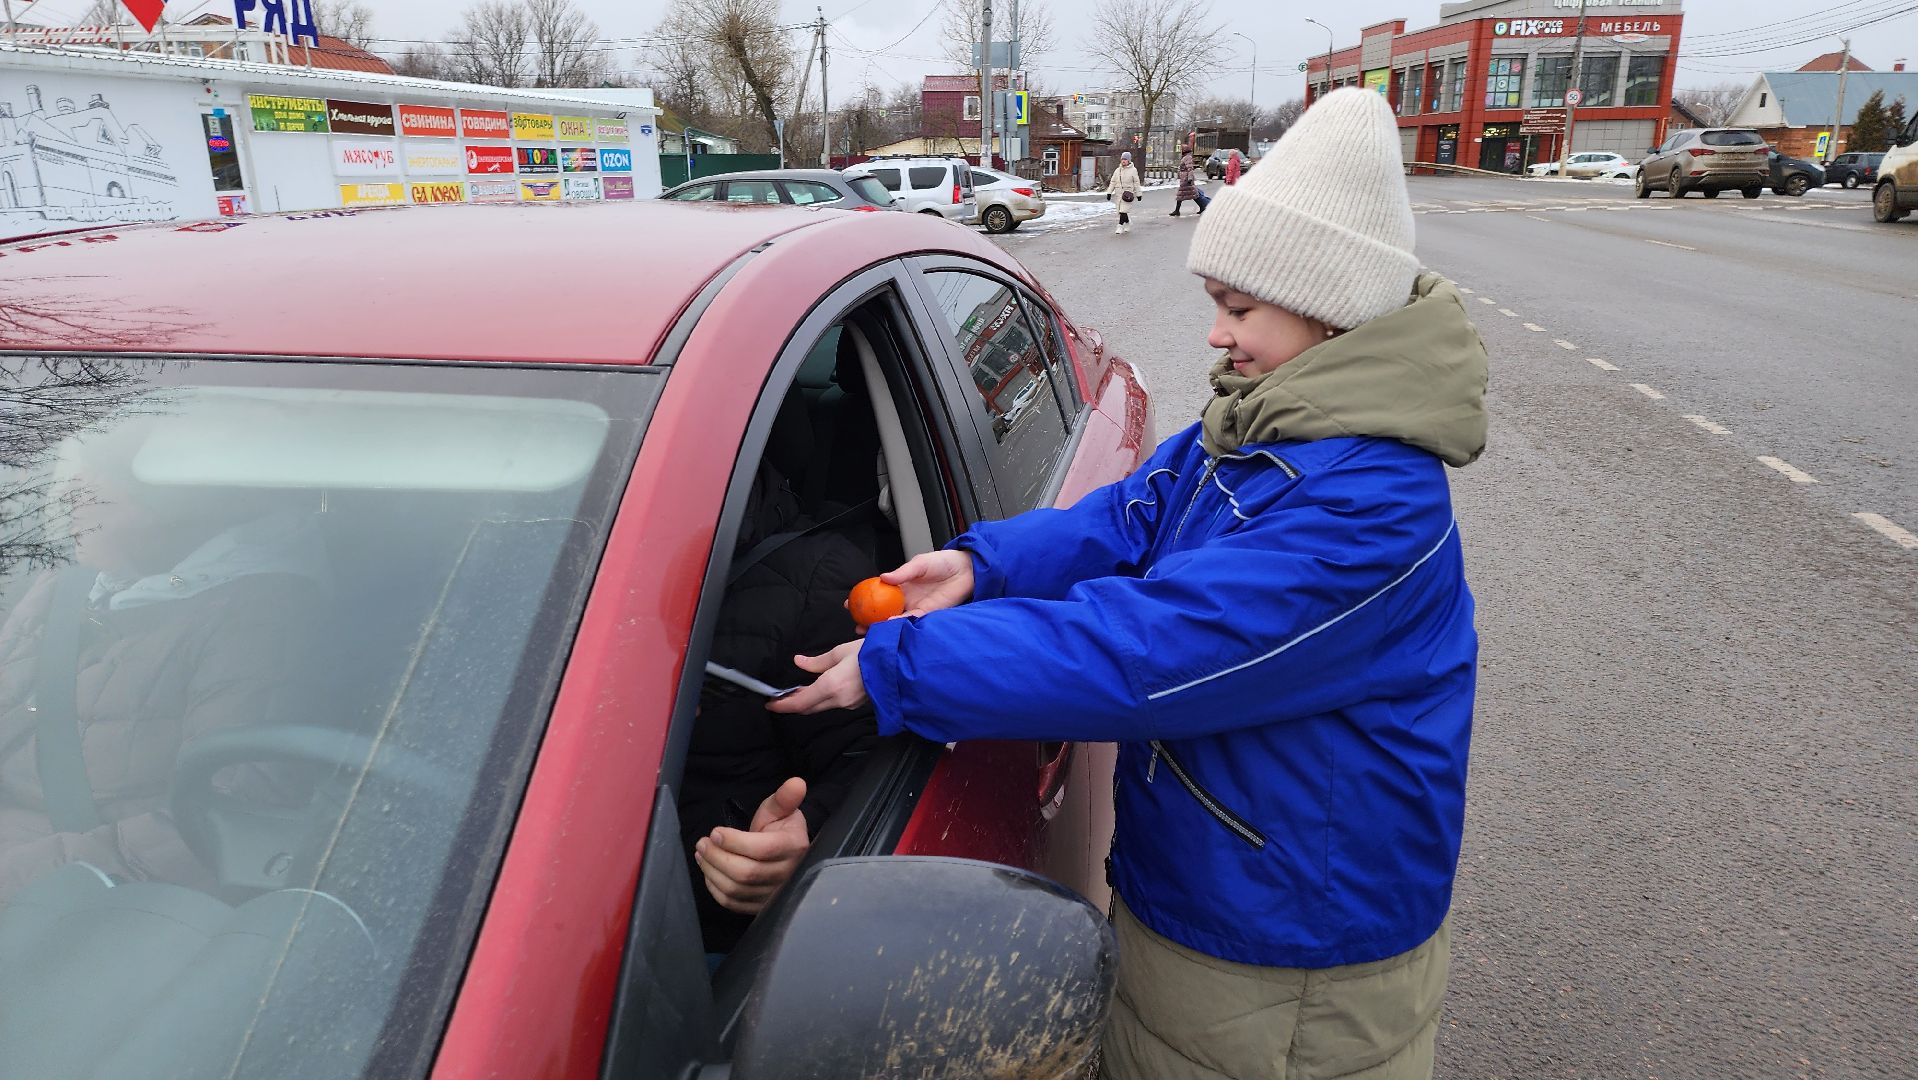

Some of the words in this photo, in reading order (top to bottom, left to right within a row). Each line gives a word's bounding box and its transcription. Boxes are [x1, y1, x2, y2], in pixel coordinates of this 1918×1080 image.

[234, 0, 319, 47] РЯД
[1510, 19, 1540, 36] FIX
[1537, 20, 1563, 30] price
[1600, 21, 1661, 33] МЕБЕЛЬ
[247, 95, 325, 112] ИНСТРУМЕНТЫ
[1569, 93, 1578, 101] 50
[402, 113, 455, 129] СВИНИНА
[463, 116, 508, 132] ГОВЯДИНА
[560, 120, 585, 136] ОКНА
[603, 152, 629, 168] OZON
